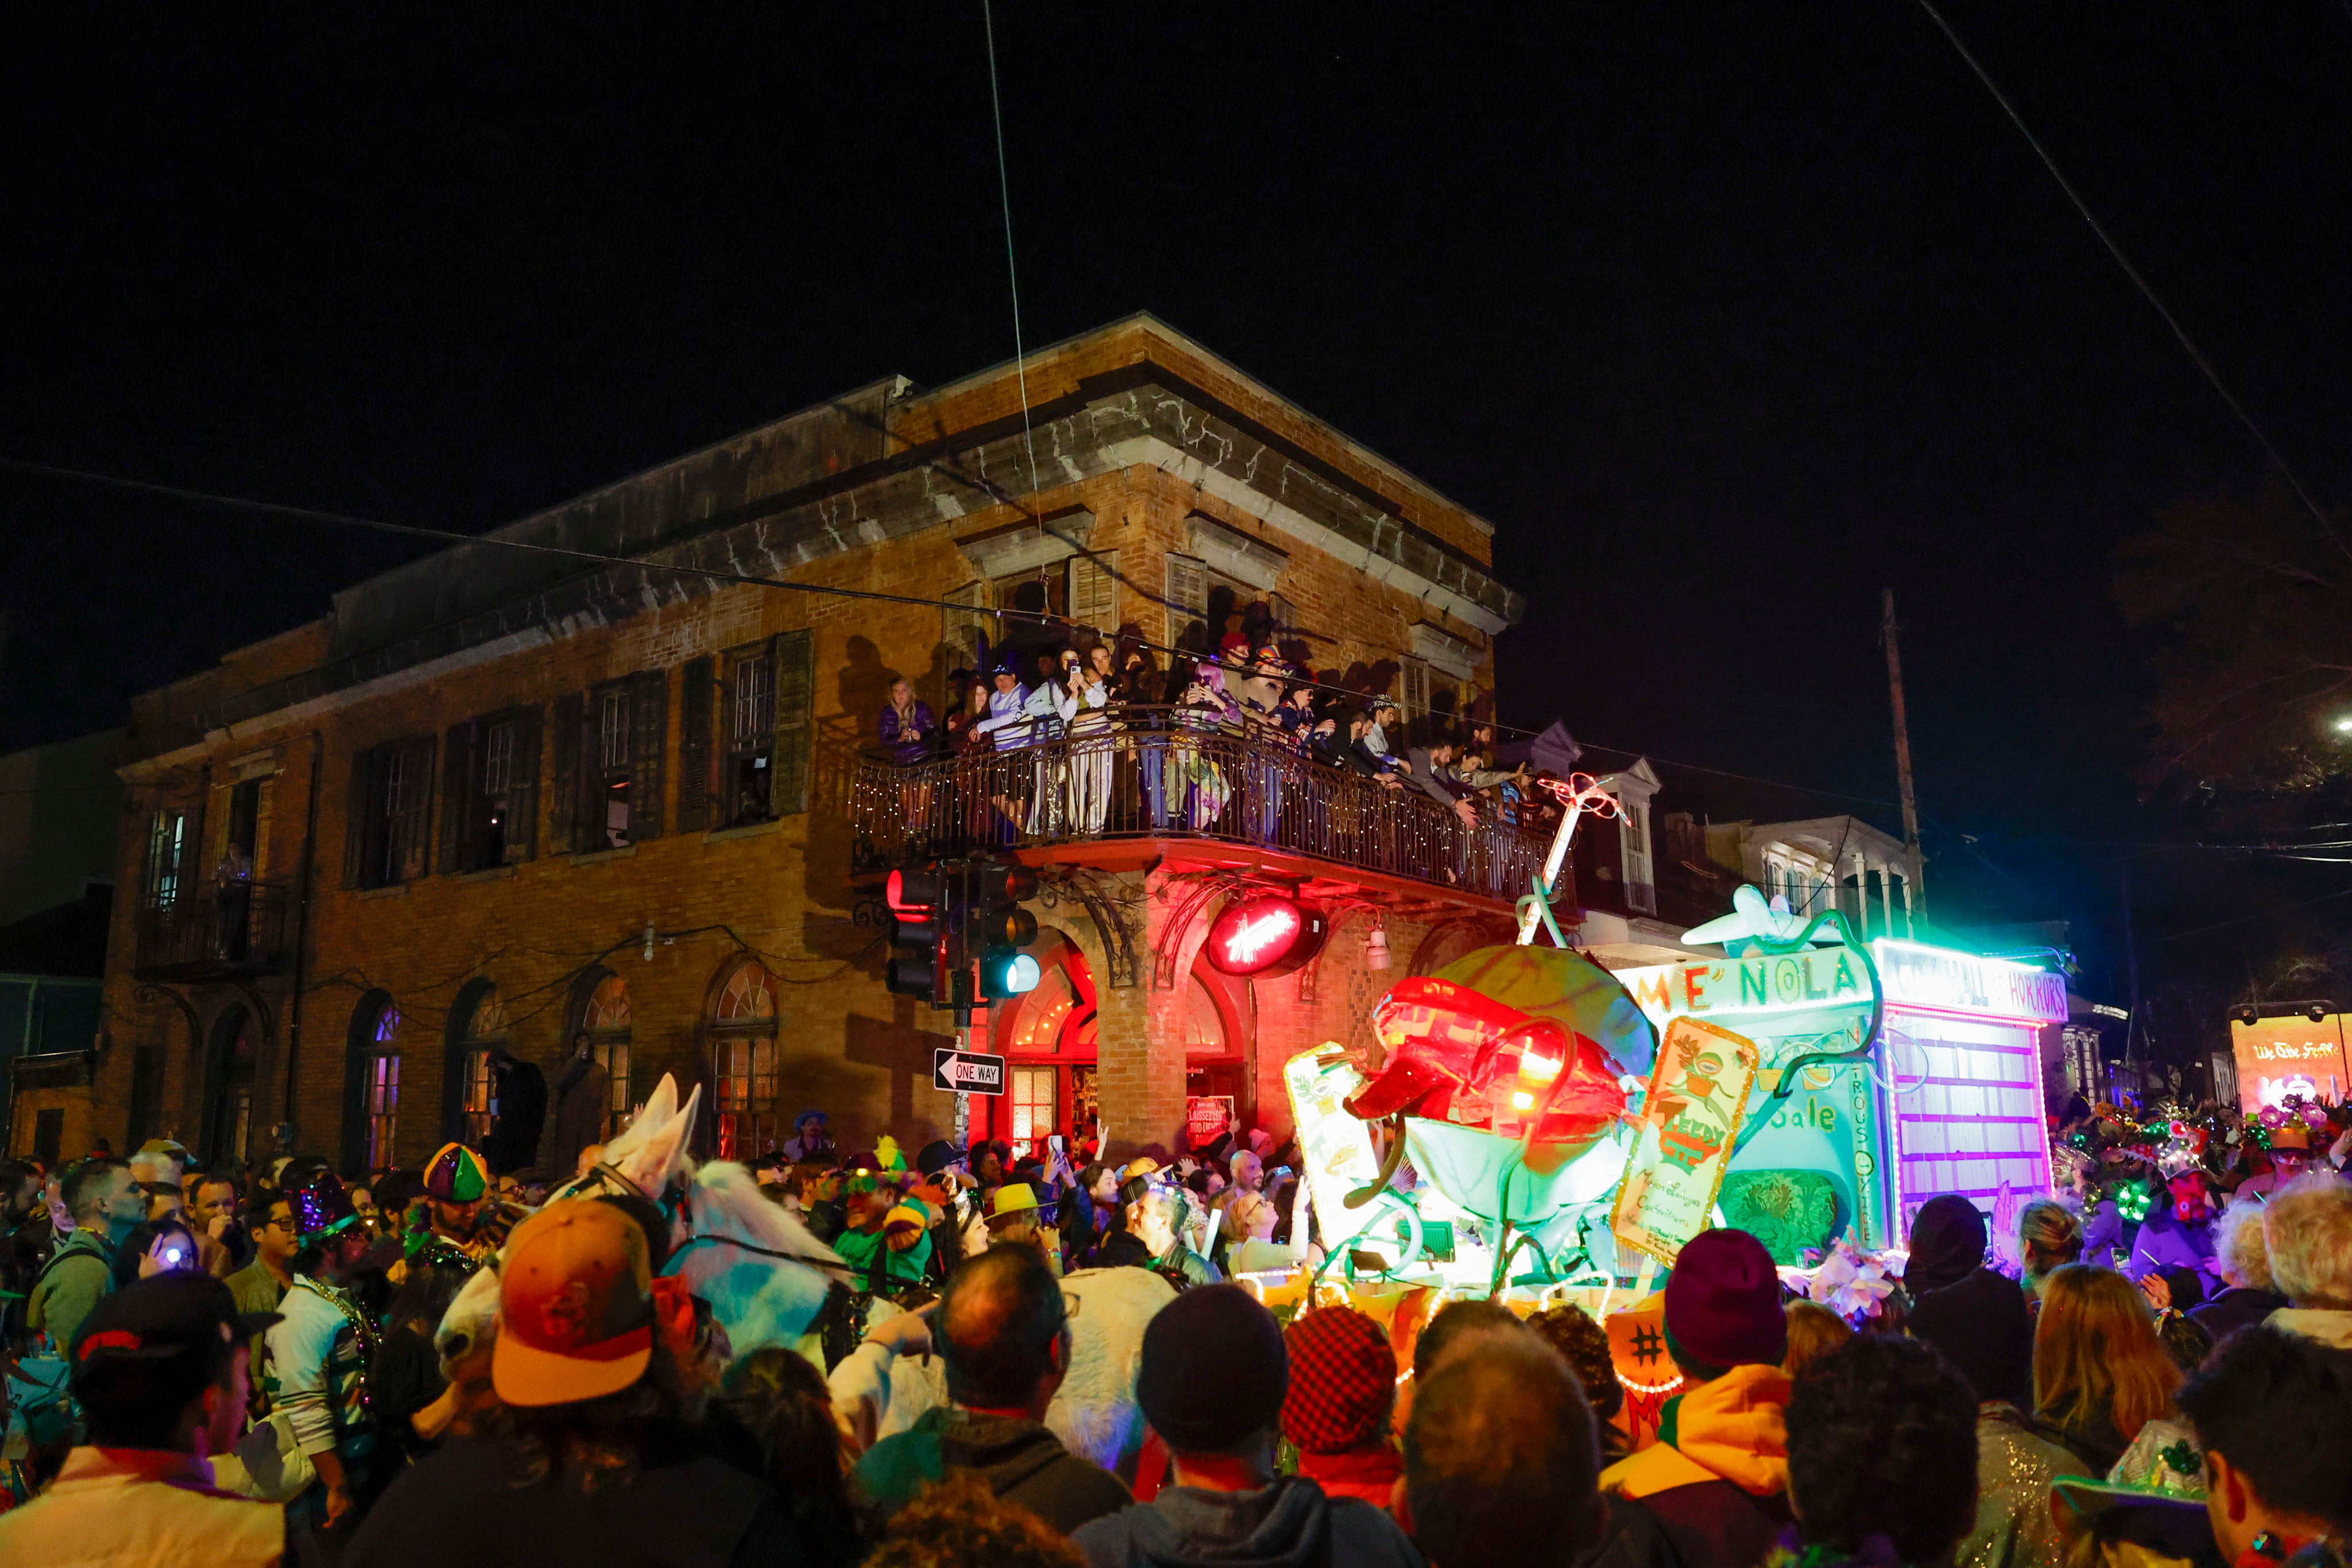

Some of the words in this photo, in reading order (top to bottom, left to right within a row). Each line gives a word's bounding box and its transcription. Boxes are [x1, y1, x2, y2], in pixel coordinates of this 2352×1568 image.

[1740, 952, 1858, 1006] NOLA
[2009, 970, 2065, 1019] HORRORS
[956, 1064, 974, 1080] ONE
[978, 1066, 997, 1082] WAY
[1846, 1027, 1868, 1144] NTROUS
[1189, 1110, 1212, 1121] LAISSEZ
[1190, 1122, 1202, 1133] BUD
